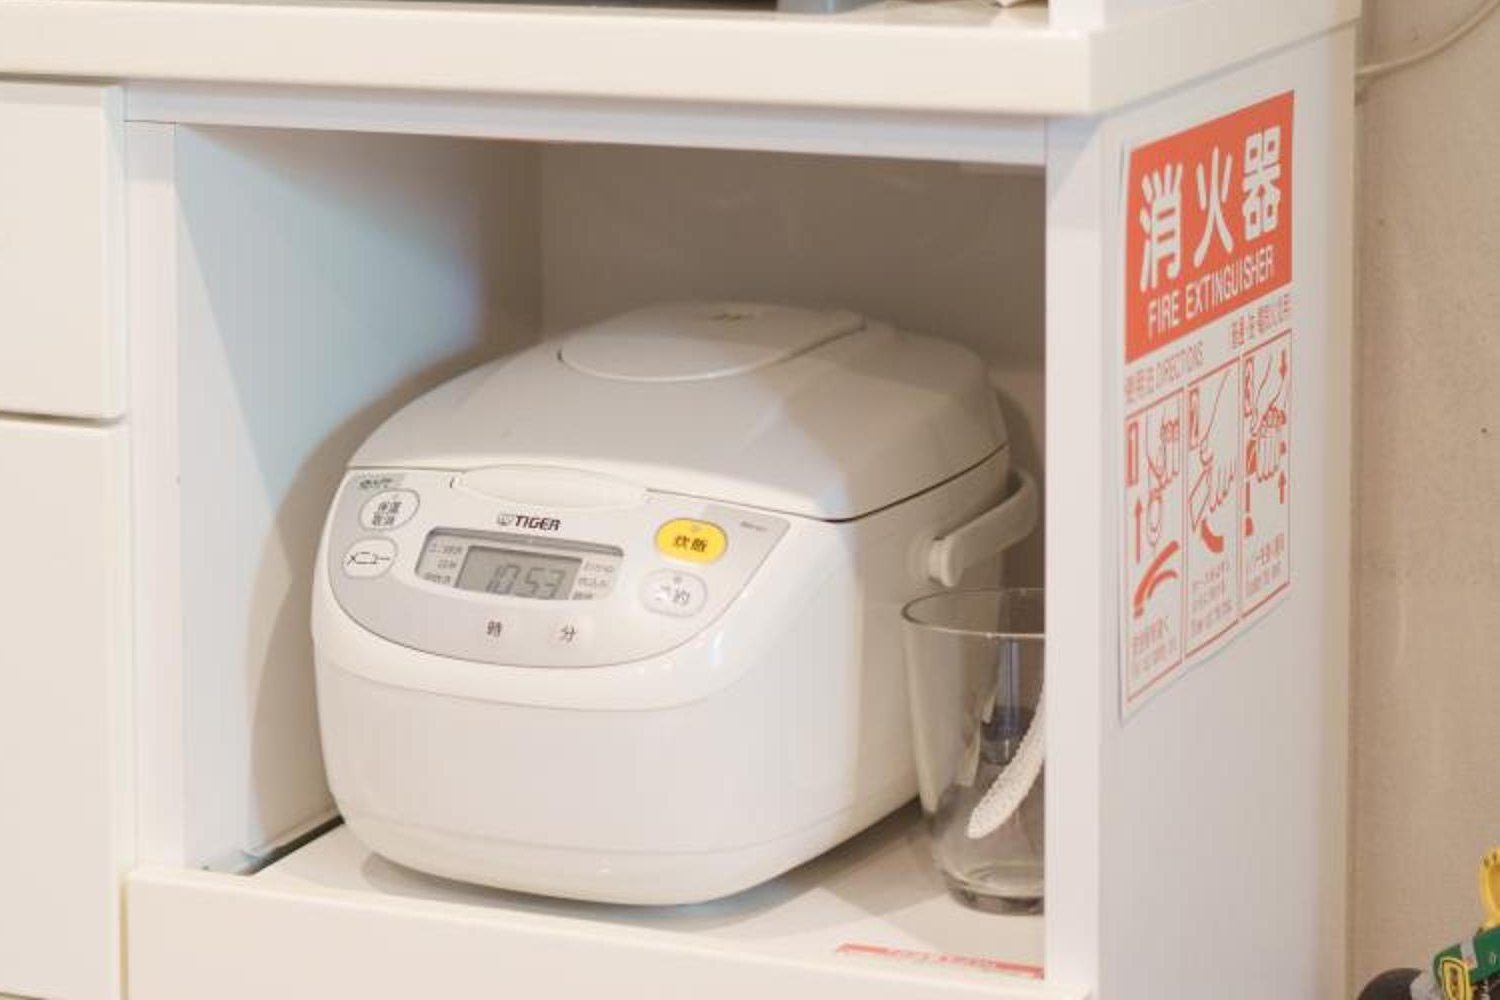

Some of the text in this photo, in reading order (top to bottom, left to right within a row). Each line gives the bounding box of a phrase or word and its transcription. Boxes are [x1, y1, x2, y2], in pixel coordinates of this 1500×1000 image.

[1139, 124, 1282, 293] 消火器
[1148, 287, 1181, 339] FIRE
[1184, 244, 1275, 321] EXTINGUISHER
[515, 514, 562, 532] TIGER
[673, 535, 708, 553] 炊飯
[486, 620, 503, 638] 時
[560, 624, 577, 643] 分
